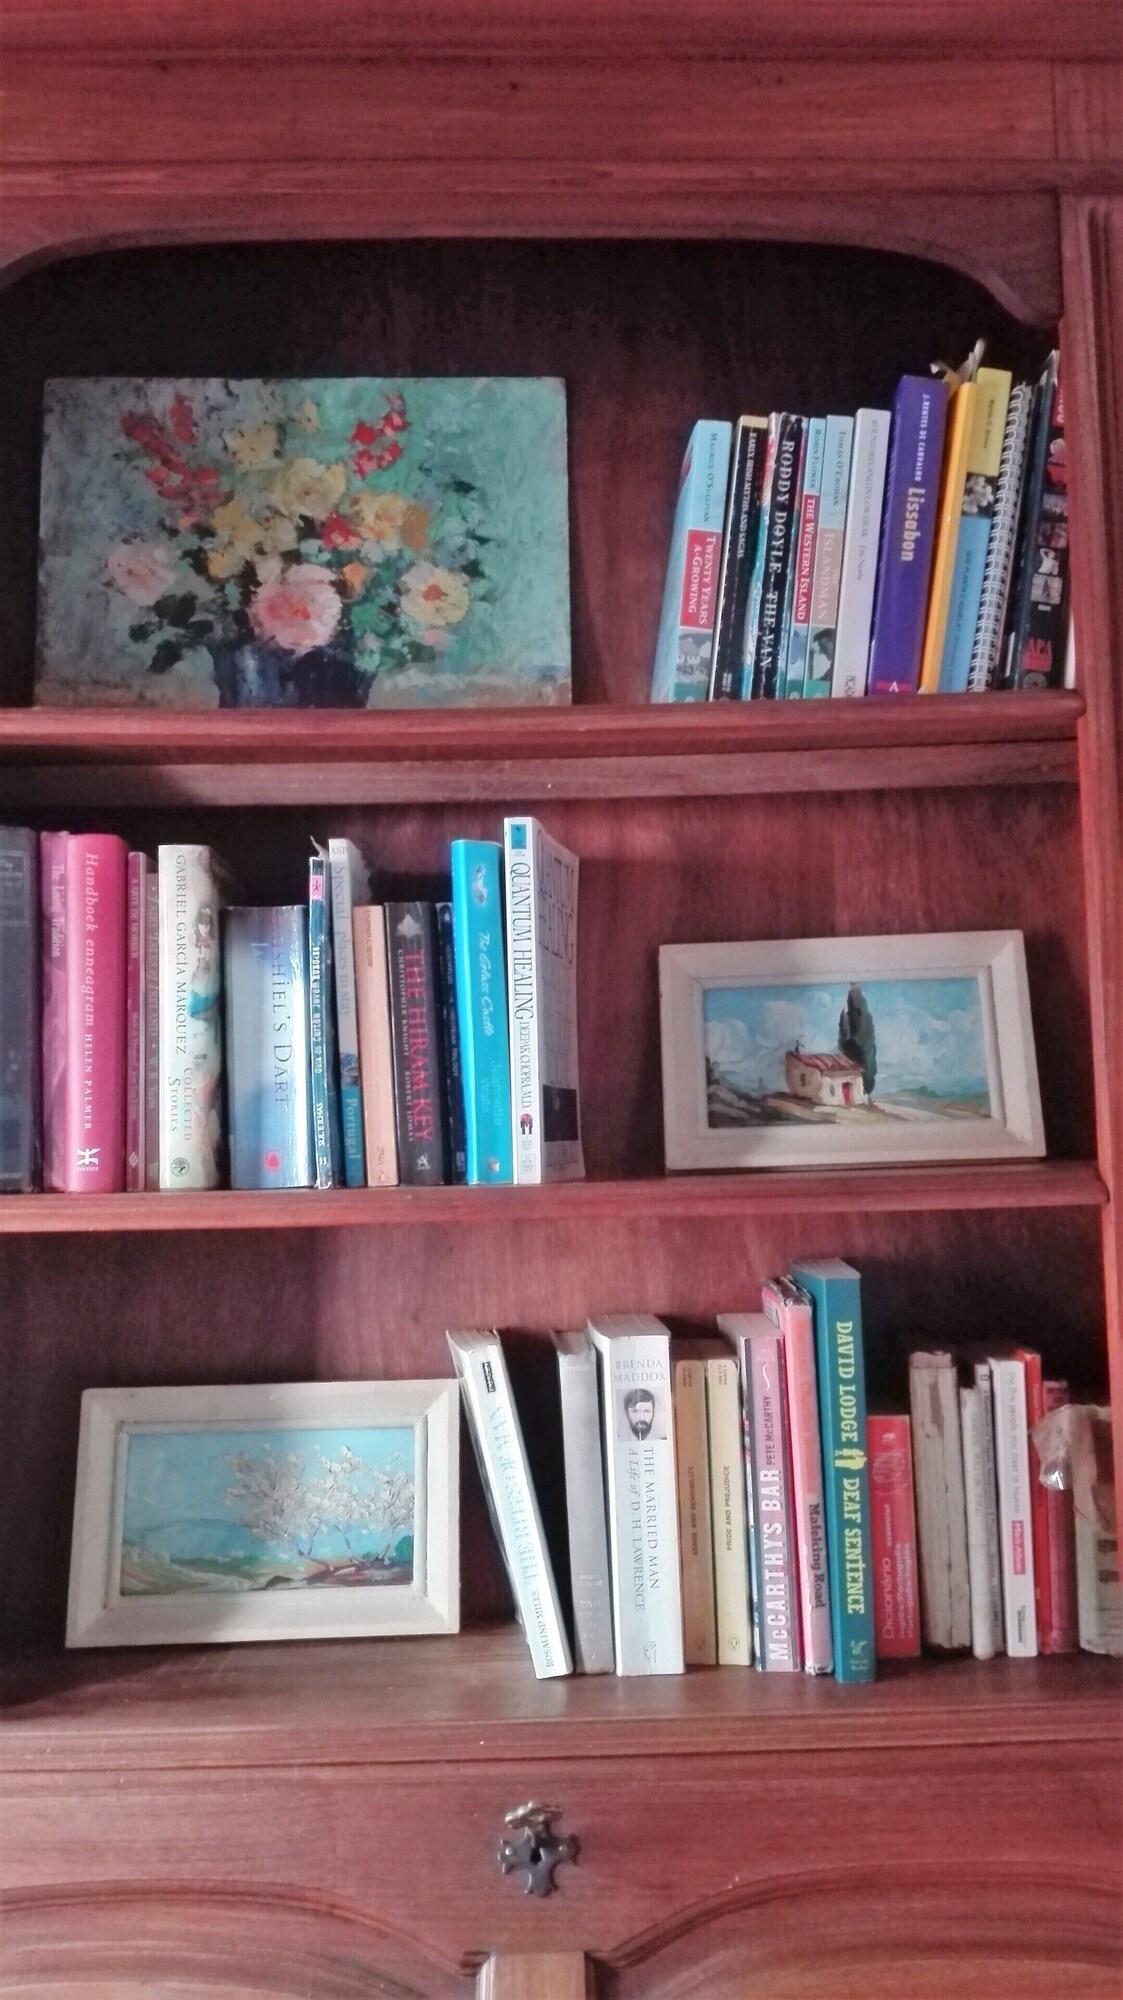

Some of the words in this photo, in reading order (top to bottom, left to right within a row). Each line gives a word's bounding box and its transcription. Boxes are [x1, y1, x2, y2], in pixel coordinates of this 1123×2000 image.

[707, 432, 718, 471] MAURICE
[747, 432, 757, 458] EARLY
[918, 430, 927, 441] DE
[745, 459, 755, 481] IRISH
[777, 440, 795, 505] RODDY
[809, 456, 819, 488] FLOWER
[914, 442, 926, 482] CARVALHO
[742, 481, 752, 511] MYTHS
[806, 498, 815, 521] THE
[740, 513, 748, 531] AND
[900, 487, 925, 562] Lissabon
[702, 536, 716, 589] TWENTY
[738, 532, 746, 558] SAGAS
[769, 511, 787, 574] DOYLE
[801, 522, 815, 577] WESTERN
[688, 544, 702, 613] A-GROWING
[817, 533, 835, 620] ISLANDMAN
[700, 588, 712, 625] YEARS
[764, 591, 778, 628] THE
[797, 577, 810, 621] ISLAND
[759, 633, 773, 669] VAN
[51, 865, 65, 880] The
[85, 852, 98, 932] Handboek
[175, 855, 188, 917] GABRIEL
[334, 865, 349, 920] Special
[510, 862, 531, 942] QUANTUM
[52, 918, 64, 957] Tradition
[175, 922, 189, 975] GARCÍA
[335, 930, 350, 971] places
[478, 932, 490, 951] The
[81, 939, 97, 1026] enneagram
[339, 973, 349, 986] to
[398, 949, 407, 1016] CHRISTOPHER
[405, 948, 426, 998] THE
[479, 953, 491, 992] Glass
[513, 949, 534, 1020] HEALING
[173, 981, 188, 1055] MÁRQUEZ
[336, 992, 350, 1017] stay
[481, 996, 495, 1036] Castle
[84, 1033, 93, 1073] HELEN
[401, 1018, 410, 1057] KNIGHT
[408, 1006, 431, 1090] HIRAM
[519, 1021, 530, 1053] DEEPAK
[273, 1043, 292, 1107] DART
[404, 1071, 412, 1106] ROBERT
[490, 1060, 504, 1126] Jeannette
[83, 1080, 93, 1130] PALMER
[167, 1077, 180, 1131] STORIES
[183, 1067, 193, 1141] COLLECTED
[480, 1078, 491, 1113] Walls
[344, 1097, 361, 1159] Portugal
[406, 1110, 414, 1143] LOMAS
[414, 1098, 433, 1142] KEY
[616, 1360, 663, 1370] BRENDA
[836, 1321, 855, 1379] DAVID
[613, 1374, 667, 1384] MADDOX
[1009, 1371, 1017, 1385] the
[1009, 1387, 1018, 1402] five
[487, 1406, 514, 1450] MAN
[763, 1395, 774, 1440] McCARTHY
[839, 1384, 858, 1442] LODGE
[1008, 1404, 1019, 1431] people
[628, 1448, 638, 1457] A
[643, 1447, 655, 1475] THE
[765, 1441, 775, 1465] PETE
[1008, 1435, 1018, 1450] you
[1011, 1453, 1020, 1472] meet
[628, 1460, 639, 1480] Life
[628, 1483, 641, 1496] of
[723, 1466, 731, 1507] PREJUDICE
[631, 1501, 641, 1515] D.
[760, 1470, 782, 1512] BAR
[843, 1477, 861, 1523] DEAF
[1012, 1486, 1022, 1514] heaven
[632, 1519, 642, 1534] H.
[645, 1481, 657, 1549] MARRIED
[808, 1504, 823, 1570] Mafeking
[515, 1543, 541, 1584] THE
[632, 1538, 646, 1611] LAWRENCE
[648, 1555, 660, 1590] MAN
[845, 1528, 866, 1614] SENTENCE
[531, 1590, 543, 1619] MILES
[763, 1522, 790, 1660] McCARTHY'S
[813, 1574, 826, 1609] Road
[881, 1557, 894, 1639] Dicionário
[535, 1621, 554, 1668] ROSALIND
